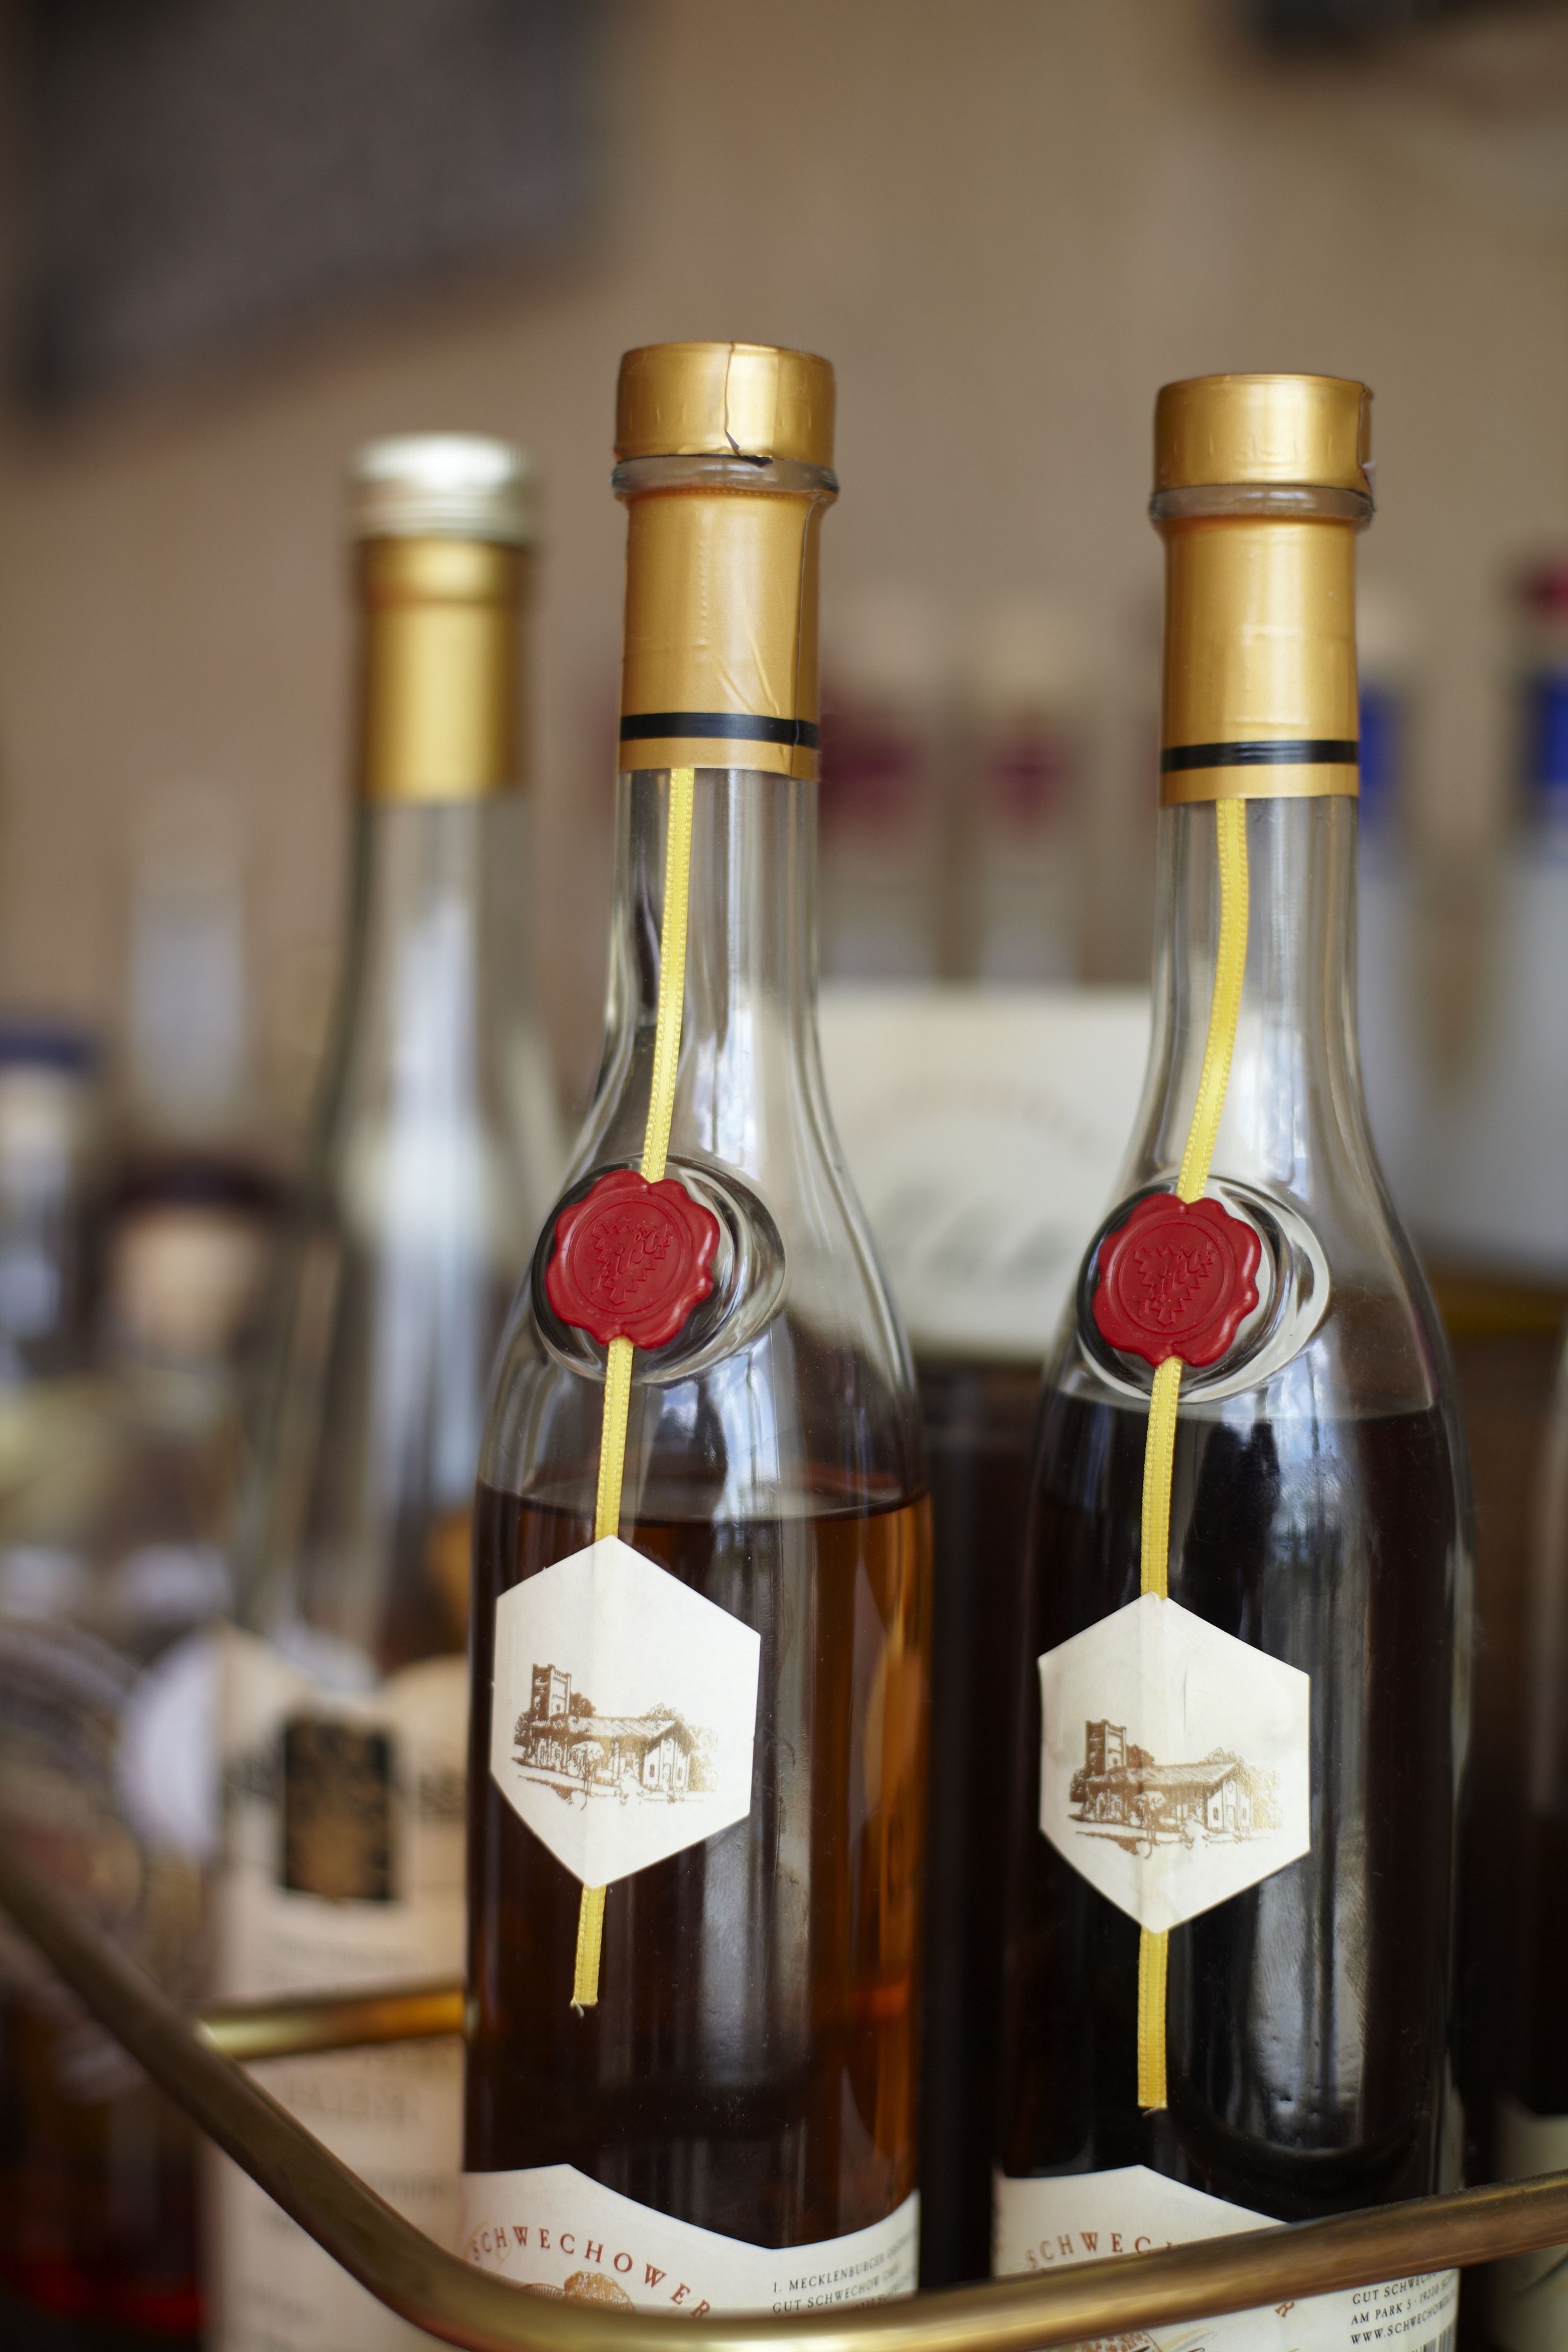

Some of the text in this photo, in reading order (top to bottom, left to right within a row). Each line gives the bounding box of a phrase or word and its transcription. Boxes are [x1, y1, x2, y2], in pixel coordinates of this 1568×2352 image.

[472, 2225, 711, 2318] SCHWECHOWER
[772, 2299, 801, 2314] GUT
[1352, 2289, 1379, 2305] GUT
[1351, 2312, 1370, 2325] AM
[1375, 2302, 1403, 2320] PARK
